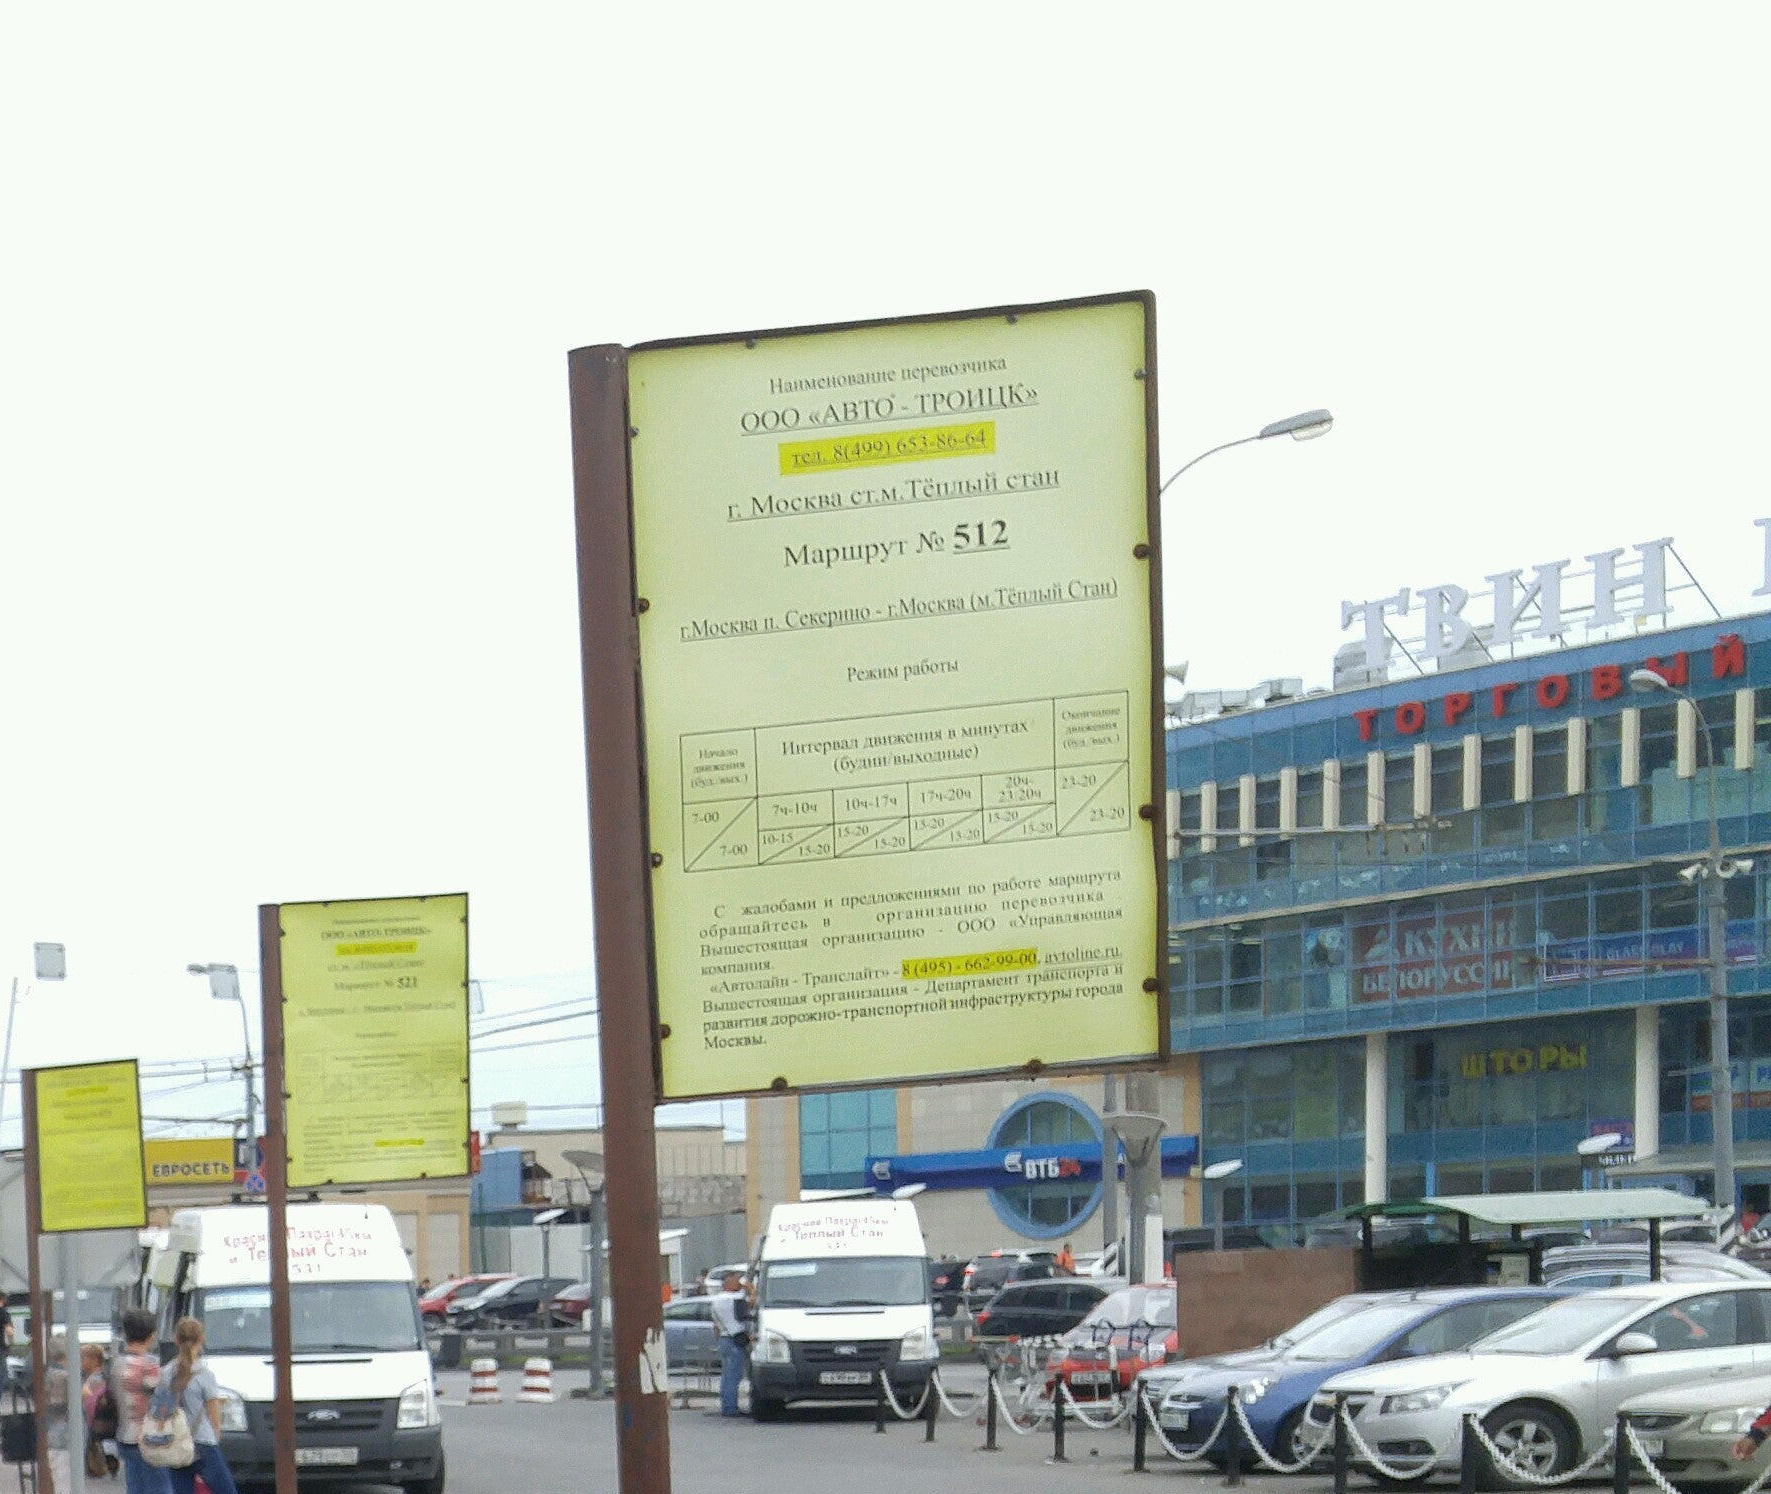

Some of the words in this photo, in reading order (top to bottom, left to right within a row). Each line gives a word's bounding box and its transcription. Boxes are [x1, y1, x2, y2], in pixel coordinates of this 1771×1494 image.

[769, 368, 896, 395] Наименование
[901, 357, 1007, 383] перевозчика
[740, 408, 800, 433] ООО
[792, 450, 828, 468] тел.
[727, 503, 742, 520] г.
[750, 491, 842, 518] Москва
[1006, 469, 1060, 490] стан
[783, 539, 908, 570] Маршрут
[915, 532, 945, 555] №
[953, 518, 1010, 550] 512
[785, 606, 871, 629] Секерино
[1067, 577, 1119, 599] Стан)
[1341, 537, 1675, 676] ТВИН
[846, 664, 899, 683] Режим
[903, 656, 959, 682] работы
[1354, 633, 1747, 742] ТОРГОВЫЙ
[782, 737, 859, 757] Интервал
[862, 728, 943, 750] движения
[947, 728, 957, 739] в
[961, 721, 1029, 740] минутах
[833, 744, 979, 774] (будни/выходные)
[691, 811, 720, 825] 7-00
[772, 801, 818, 816] 7ч-10ч
[844, 794, 897, 811] 10ч-17ч
[719, 843, 748, 858] 7-00
[713, 905, 726, 919] С
[741, 898, 817, 916] жалобами
[824, 898, 834, 909] и
[840, 884, 961, 910] предложениями
[967, 884, 986, 896] по
[992, 876, 1042, 896] работе
[1048, 869, 1122, 890] маршрута
[699, 918, 808, 940] обращайтесь
[823, 917, 831, 928] в
[876, 902, 987, 925] организацию
[1001, 891, 1104, 912] перевозчика
[700, 937, 808, 958] Вышестоящая
[822, 927, 925, 949] организацию
[957, 917, 996, 935] ООО
[1009, 908, 1123, 930] «Управляющая
[702, 994, 807, 1014] Вышестоящая
[812, 984, 908, 1006] организация
[924, 973, 1020, 996] Департамент
[1026, 964, 1110, 986] транспорта
[1114, 964, 1123, 976] и
[710, 976, 789, 995] «Автолайн
[801, 965, 890, 986] Транслайт»
[703, 1016, 768, 1035] развития
[770, 998, 947, 1027] дорожно-транспортной
[950, 987, 1073, 1010] инфраструктуры
[1075, 983, 1124, 1000] города
[704, 1035, 767, 1050] Москвы.
[1461, 1044, 1588, 1079] ШТОРЫ
[152, 1160, 230, 1178] ЕВРОСЕТЬ
